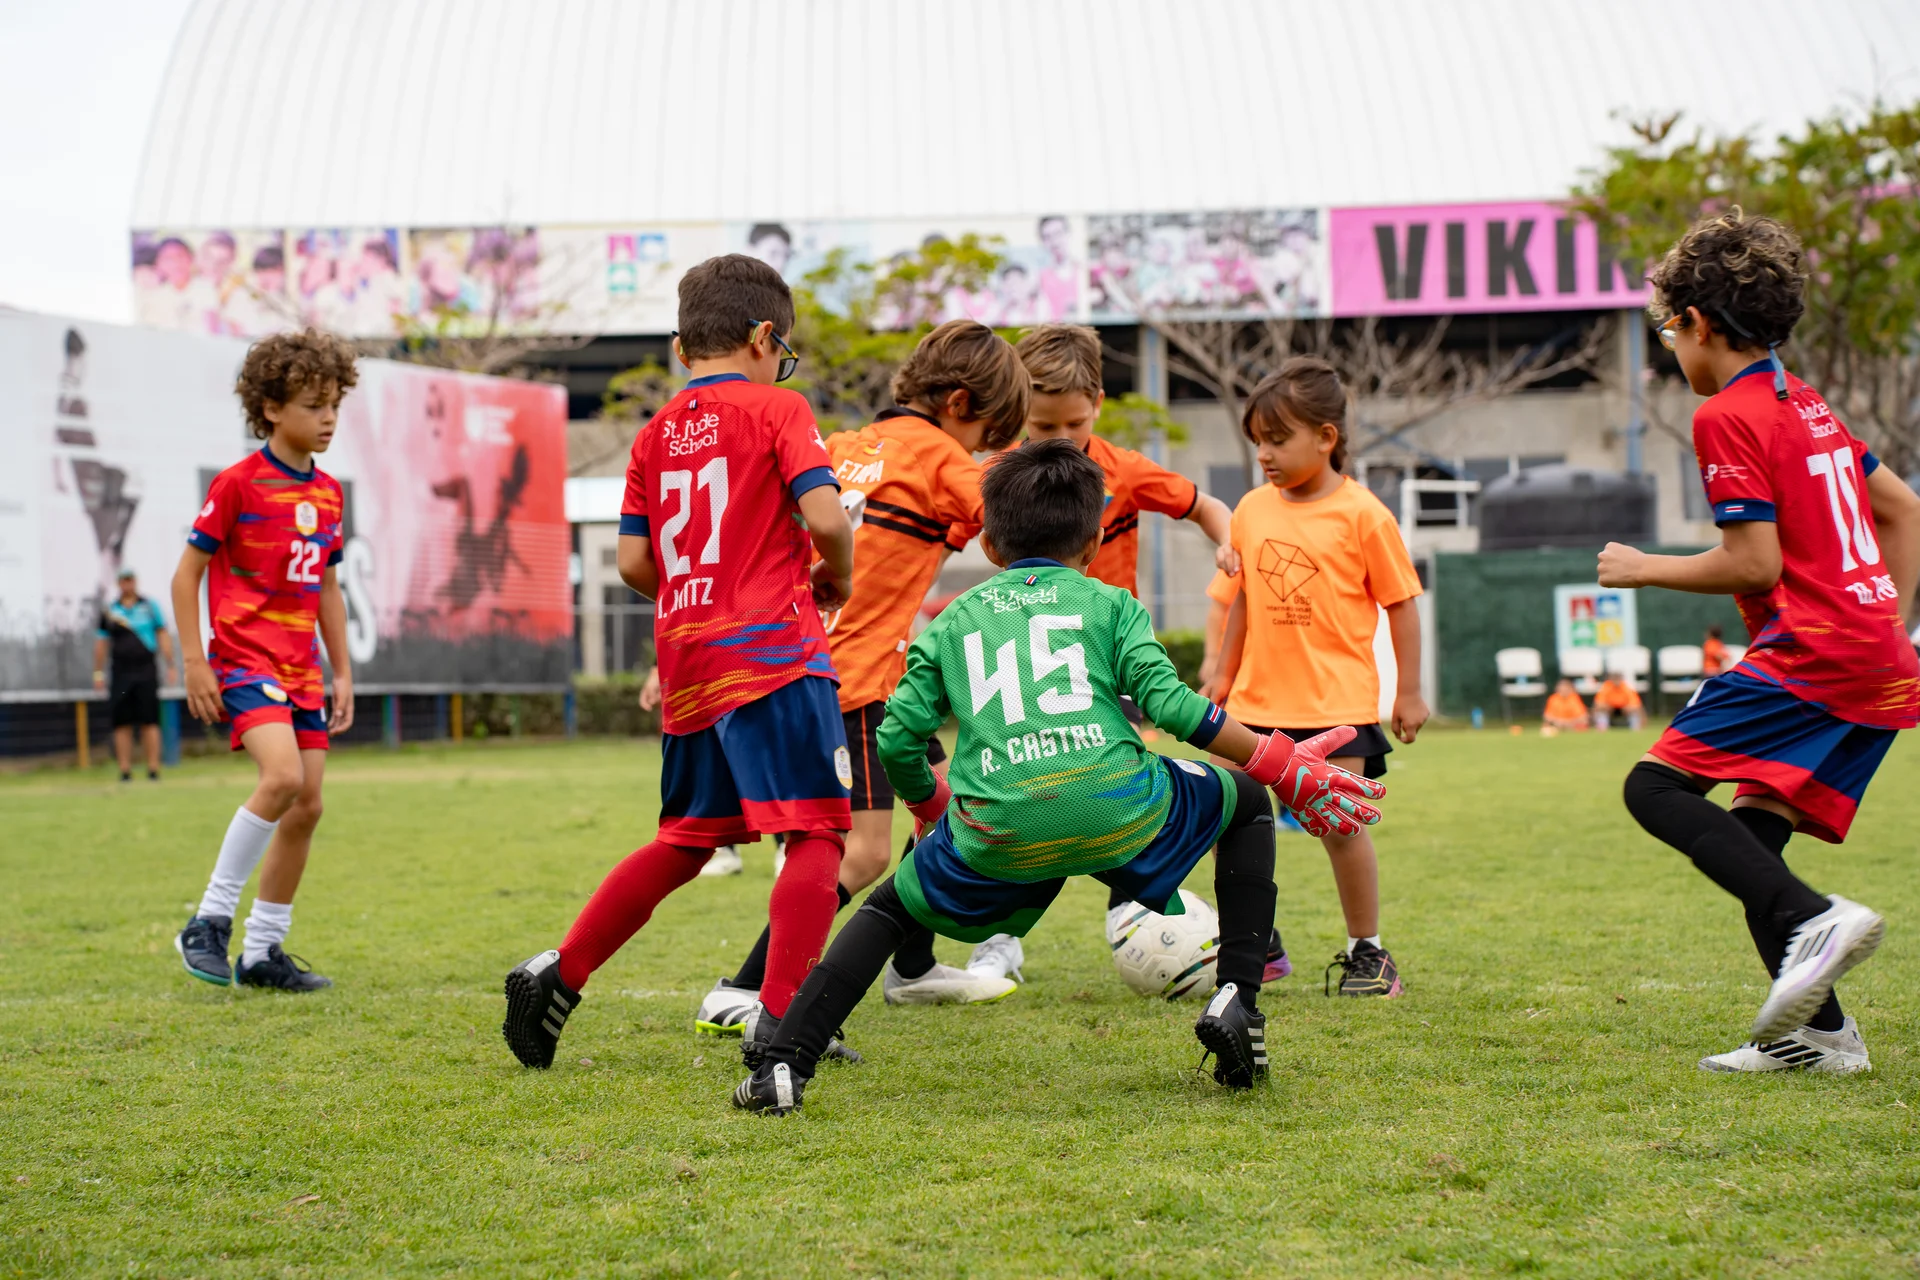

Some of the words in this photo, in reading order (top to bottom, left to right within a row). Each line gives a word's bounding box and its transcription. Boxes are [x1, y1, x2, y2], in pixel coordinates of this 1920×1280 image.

[669, 428, 718, 457] School
[681, 413, 720, 442] Jude
[660, 456, 729, 583] 21
[286, 539, 321, 583] 22
[963, 613, 1094, 727] 45
[981, 747, 1001, 777] R.
[1006, 723, 1107, 766] CASTRO
